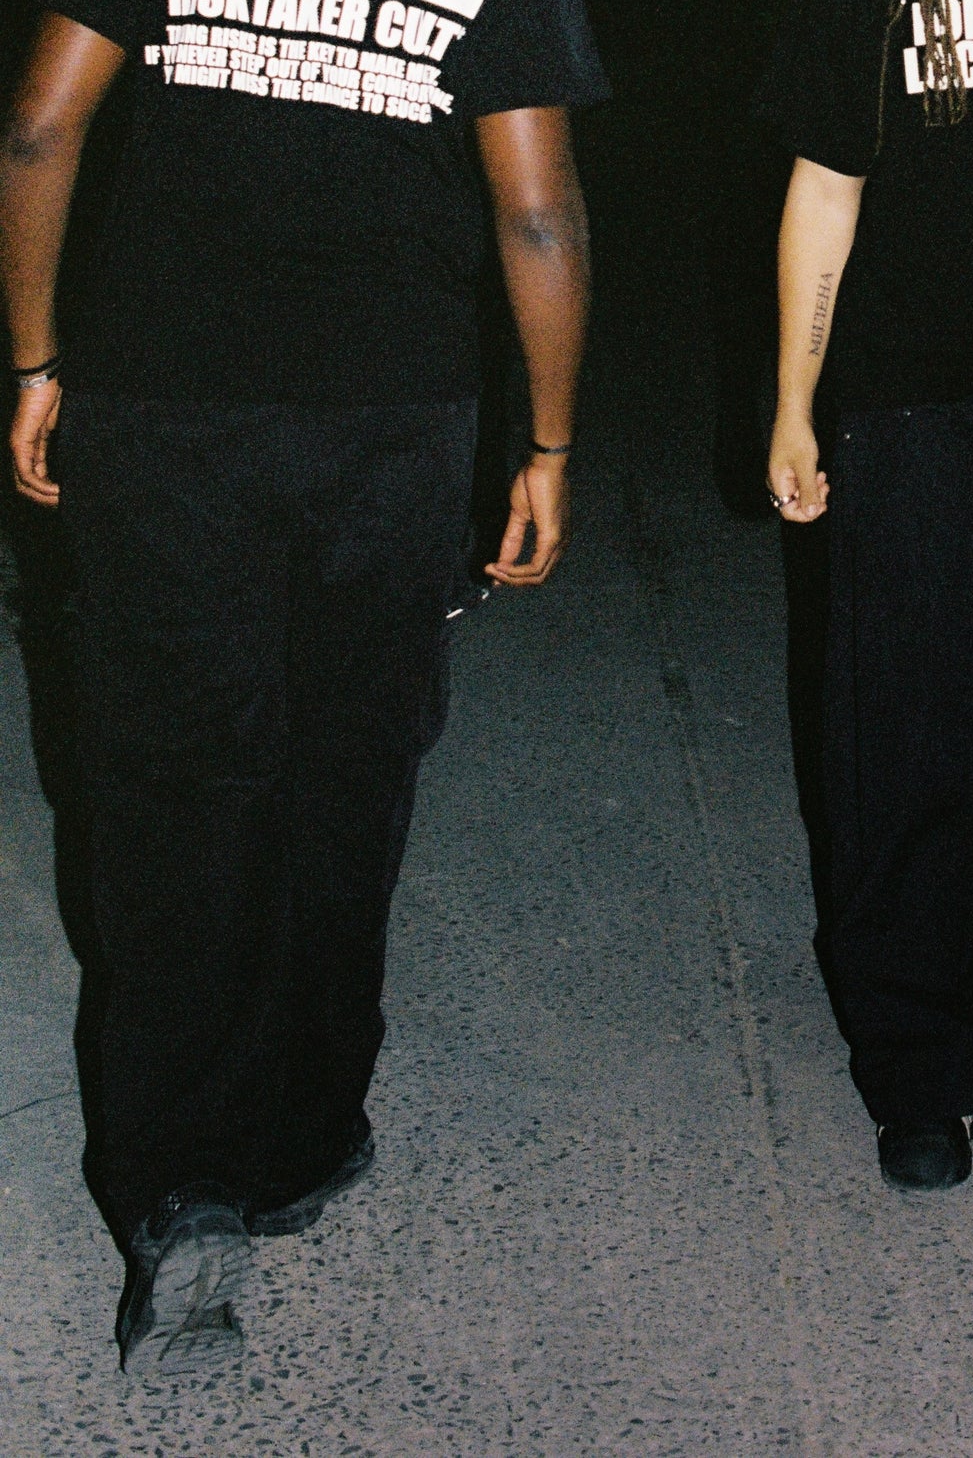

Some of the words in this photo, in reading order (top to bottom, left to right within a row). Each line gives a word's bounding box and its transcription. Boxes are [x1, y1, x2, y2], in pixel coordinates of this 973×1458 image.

[175, 43, 229, 68] NEVER
[228, 49, 266, 75] STEP
[265, 56, 300, 80] OUT
[300, 60, 322, 82] OF
[278, 38, 308, 61] THE
[335, 45, 359, 69] TO
[173, 63, 231, 89] MIGHT
[271, 77, 302, 101] THE
[302, 80, 361, 111] CHANCE
[361, 91, 385, 115] TO
[385, 95, 433, 124] SUCC
